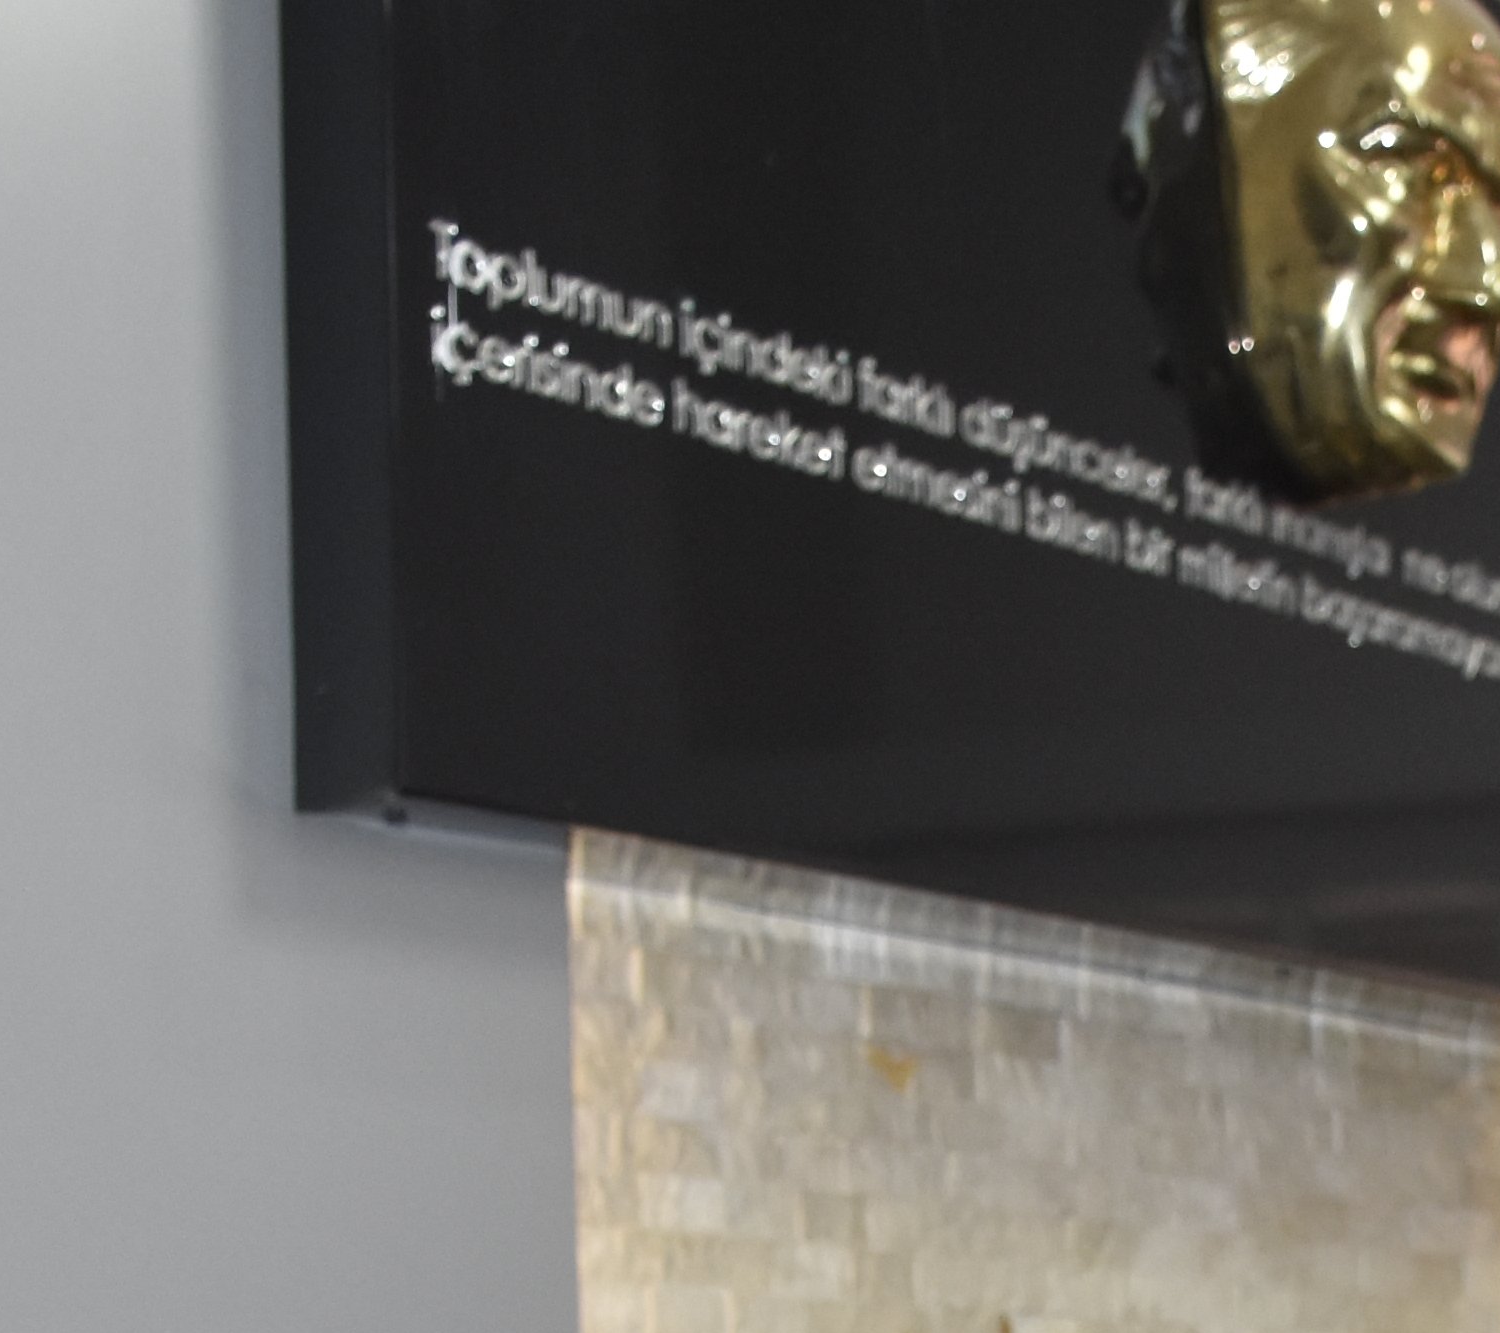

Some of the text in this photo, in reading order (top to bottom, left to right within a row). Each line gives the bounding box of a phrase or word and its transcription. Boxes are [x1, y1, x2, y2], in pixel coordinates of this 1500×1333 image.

[428, 217, 672, 349] Toplumun
[678, 297, 853, 405] içindeki
[429, 303, 666, 428] içerisinde
[670, 376, 847, 481] hareket
[851, 442, 1022, 534] etmesini
[1025, 485, 1122, 563] bilen
[1123, 517, 1175, 577] bir
